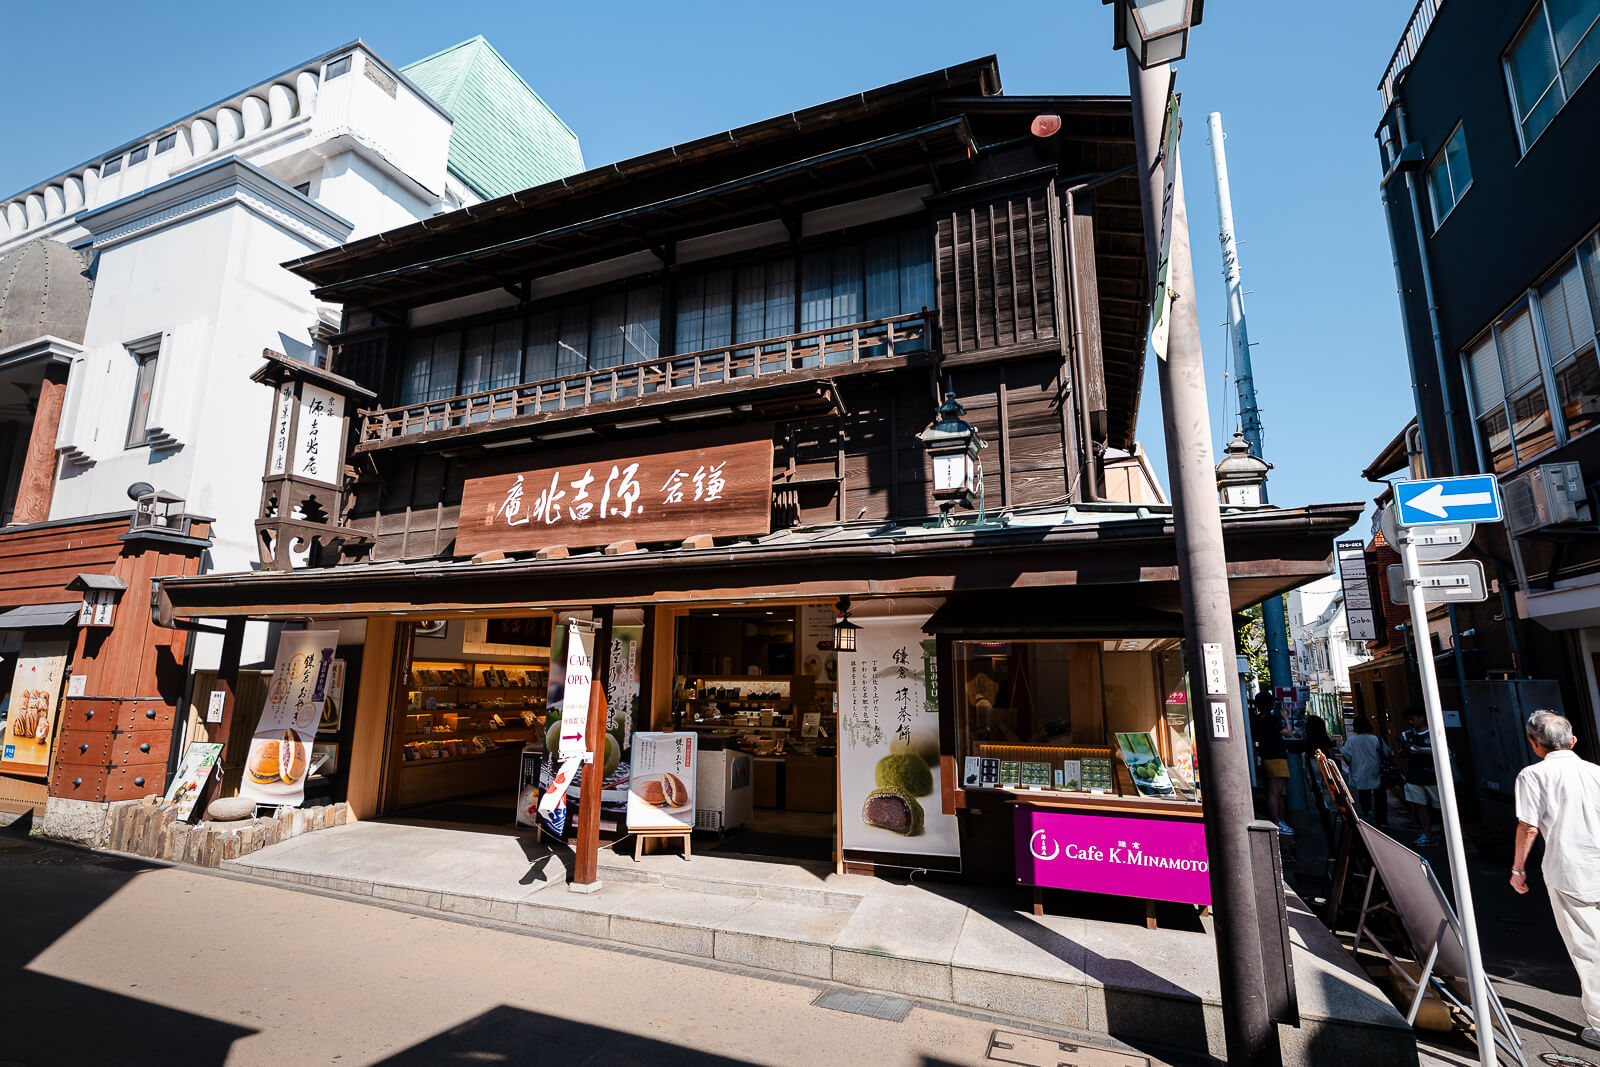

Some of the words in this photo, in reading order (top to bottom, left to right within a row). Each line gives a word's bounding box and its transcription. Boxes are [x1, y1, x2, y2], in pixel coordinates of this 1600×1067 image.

[495, 462, 645, 527] 源吉兆庵
[1350, 616, 1371, 625] Soba
[569, 654, 592, 667] CAFE
[892, 646, 910, 680] 鎌倉
[567, 674, 590, 685] OPEN
[1211, 660, 1219, 683] 904
[894, 686, 912, 746] 抹茶餅
[1065, 844, 1104, 862] Cafe
